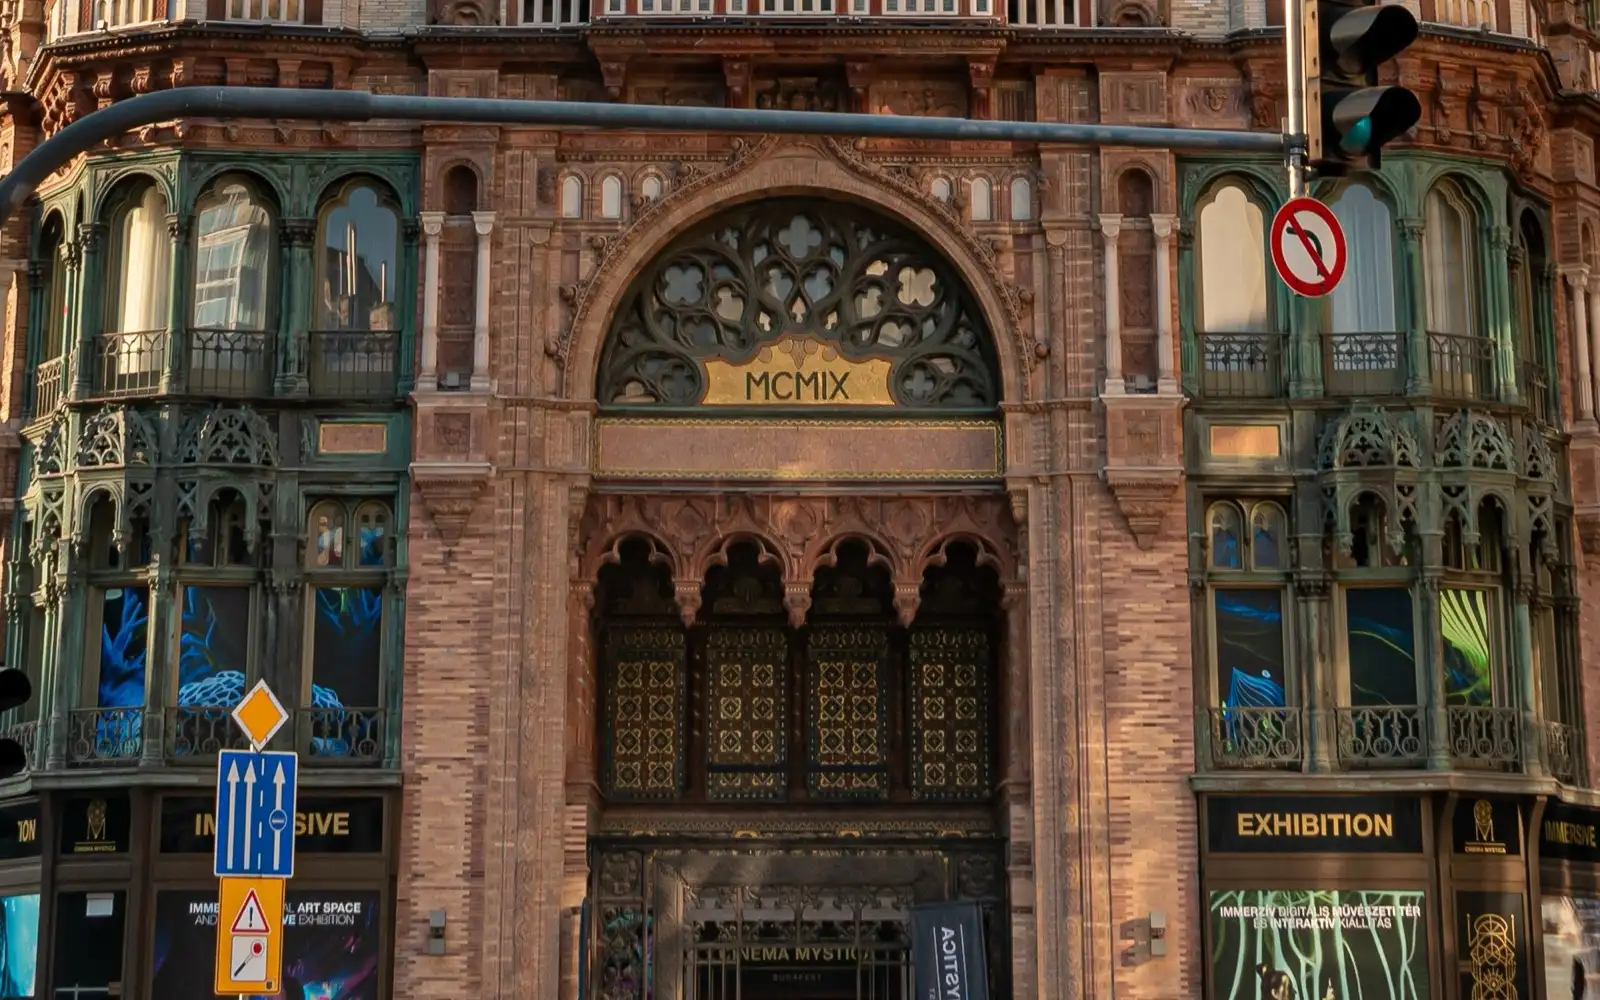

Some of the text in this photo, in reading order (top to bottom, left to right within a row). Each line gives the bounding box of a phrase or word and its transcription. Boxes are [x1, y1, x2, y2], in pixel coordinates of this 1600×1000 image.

[746, 371, 850, 400] MCMIX
[1237, 812, 1393, 837] EXHIBITION
[1544, 820, 1597, 848] IMMERSIVE
[297, 903, 321, 914] ART
[323, 903, 361, 914] SPACE
[1399, 904, 1421, 917] TÉR
[195, 914, 218, 925] AND
[299, 915, 354, 925] EXHIBITION
